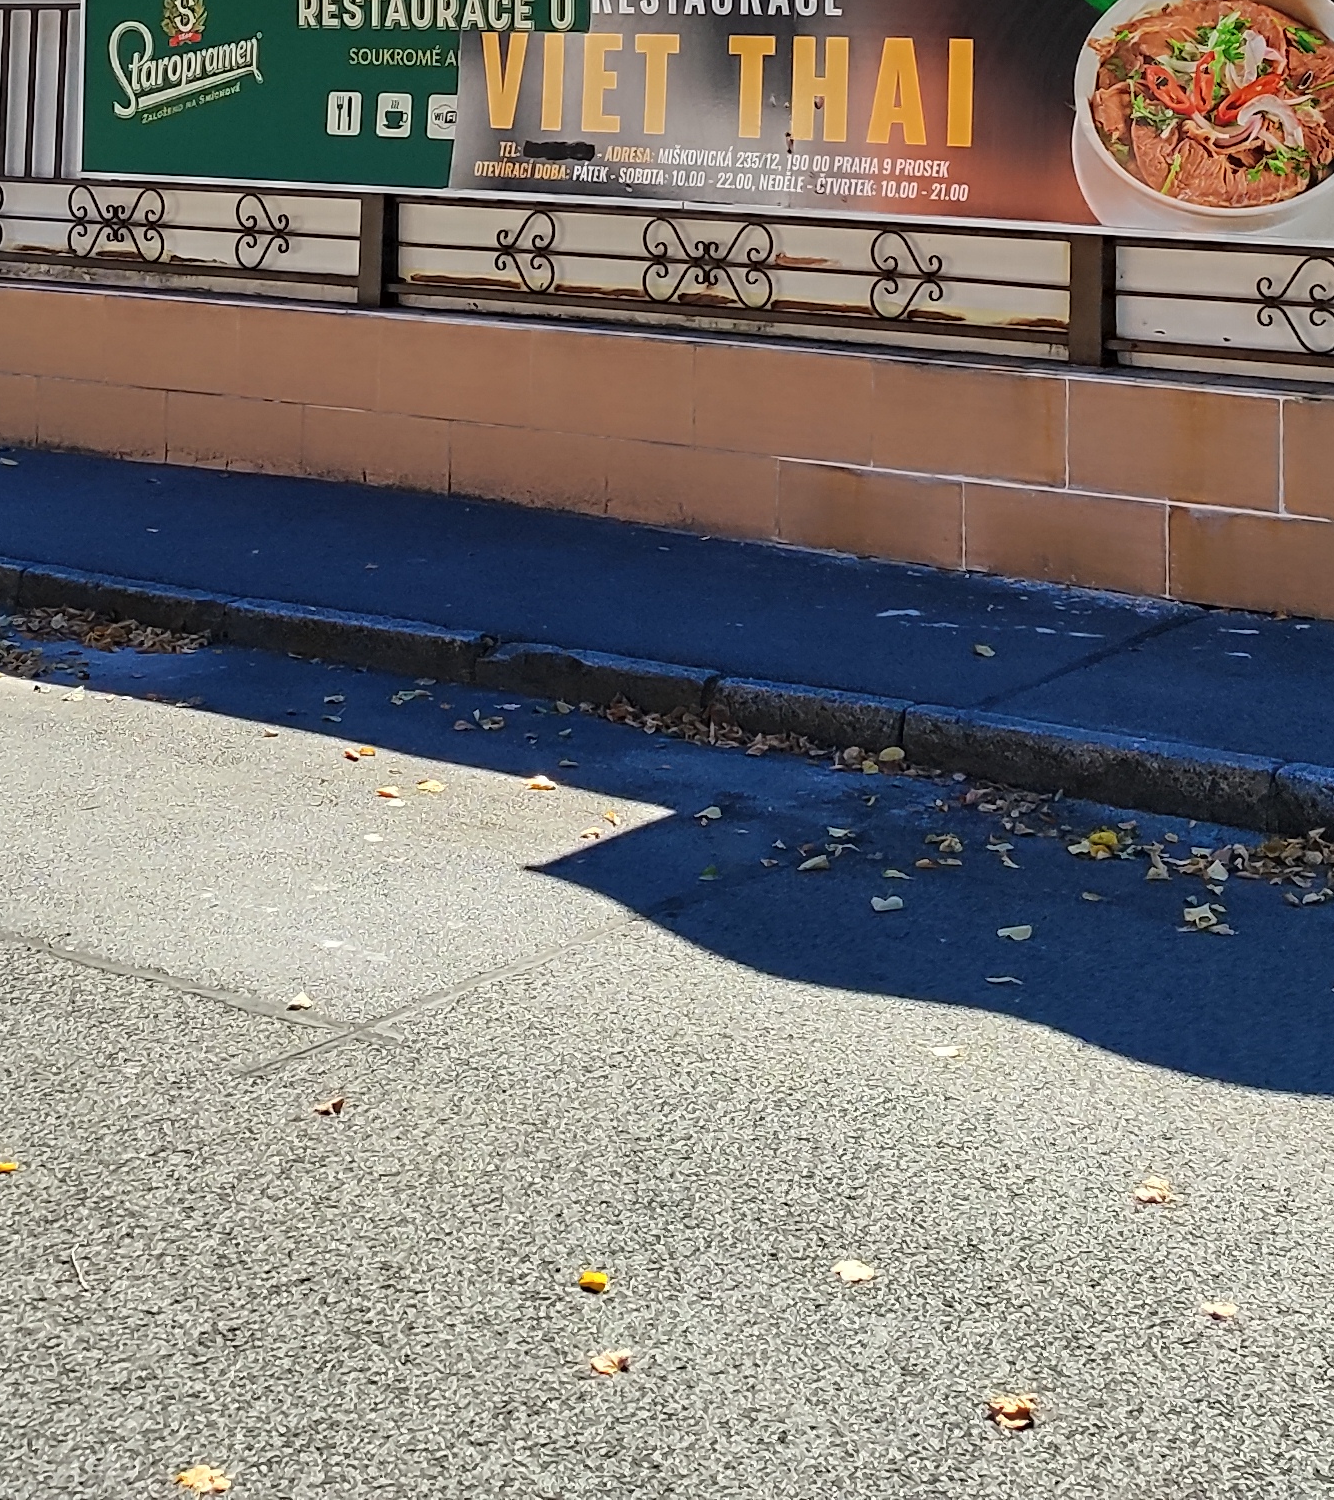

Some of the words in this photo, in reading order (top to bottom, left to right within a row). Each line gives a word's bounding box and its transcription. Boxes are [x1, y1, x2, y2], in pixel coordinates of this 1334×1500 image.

[109, 21, 264, 119] Staropramen
[349, 45, 441, 67] SOUKROMÉ
[481, 31, 681, 134] VIET
[728, 34, 975, 148] THAI
[474, 159, 533, 180] OTEVÍRACÍ
[534, 163, 570, 181] DOBA:
[572, 162, 609, 183] PÁTEK
[618, 167, 669, 186] SOBOTA:
[671, 170, 705, 187] 10.00
[716, 172, 755, 192] 22.00,
[759, 170, 805, 193] NEDĚLE
[816, 173, 877, 196] ČTVRTEK:
[881, 180, 917, 199] 10.00
[929, 183, 970, 202] 21.00
[499, 141, 521, 158] TEL:
[604, 145, 655, 163] ADRESA:
[657, 145, 732, 168] MIŠKOVICKÁ
[736, 152, 782, 172] 235/12,
[786, 154, 809, 172] 190
[812, 155, 831, 173] 00
[833, 156, 879, 175] PRAHA
[882, 158, 892, 176] 9
[895, 158, 951, 178] PROSEK
